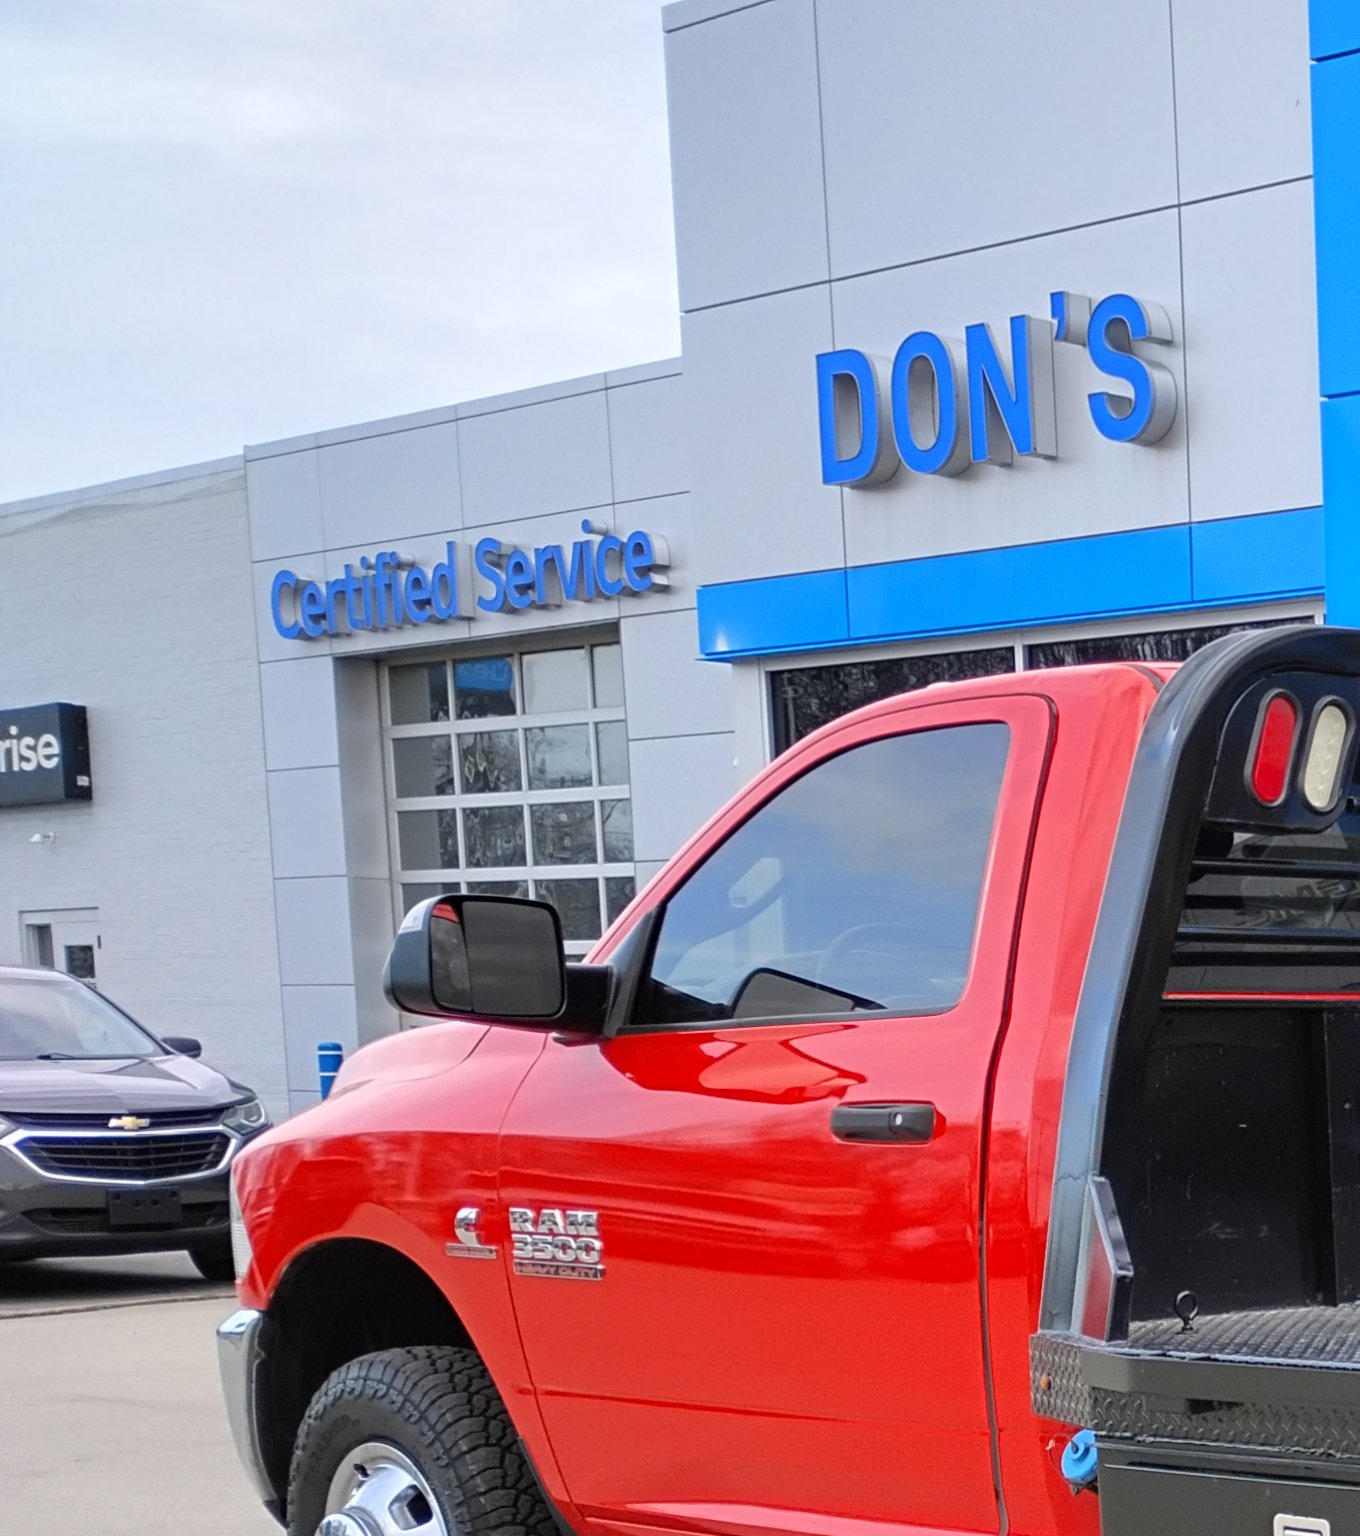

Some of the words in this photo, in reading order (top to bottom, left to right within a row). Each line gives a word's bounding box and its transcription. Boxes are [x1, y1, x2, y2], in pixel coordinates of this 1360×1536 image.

[815, 290, 1158, 487] DON'S
[271, 540, 462, 640] Certified
[474, 518, 658, 614] Service
[509, 1206, 599, 1236] RAM
[512, 1234, 602, 1263] 3500
